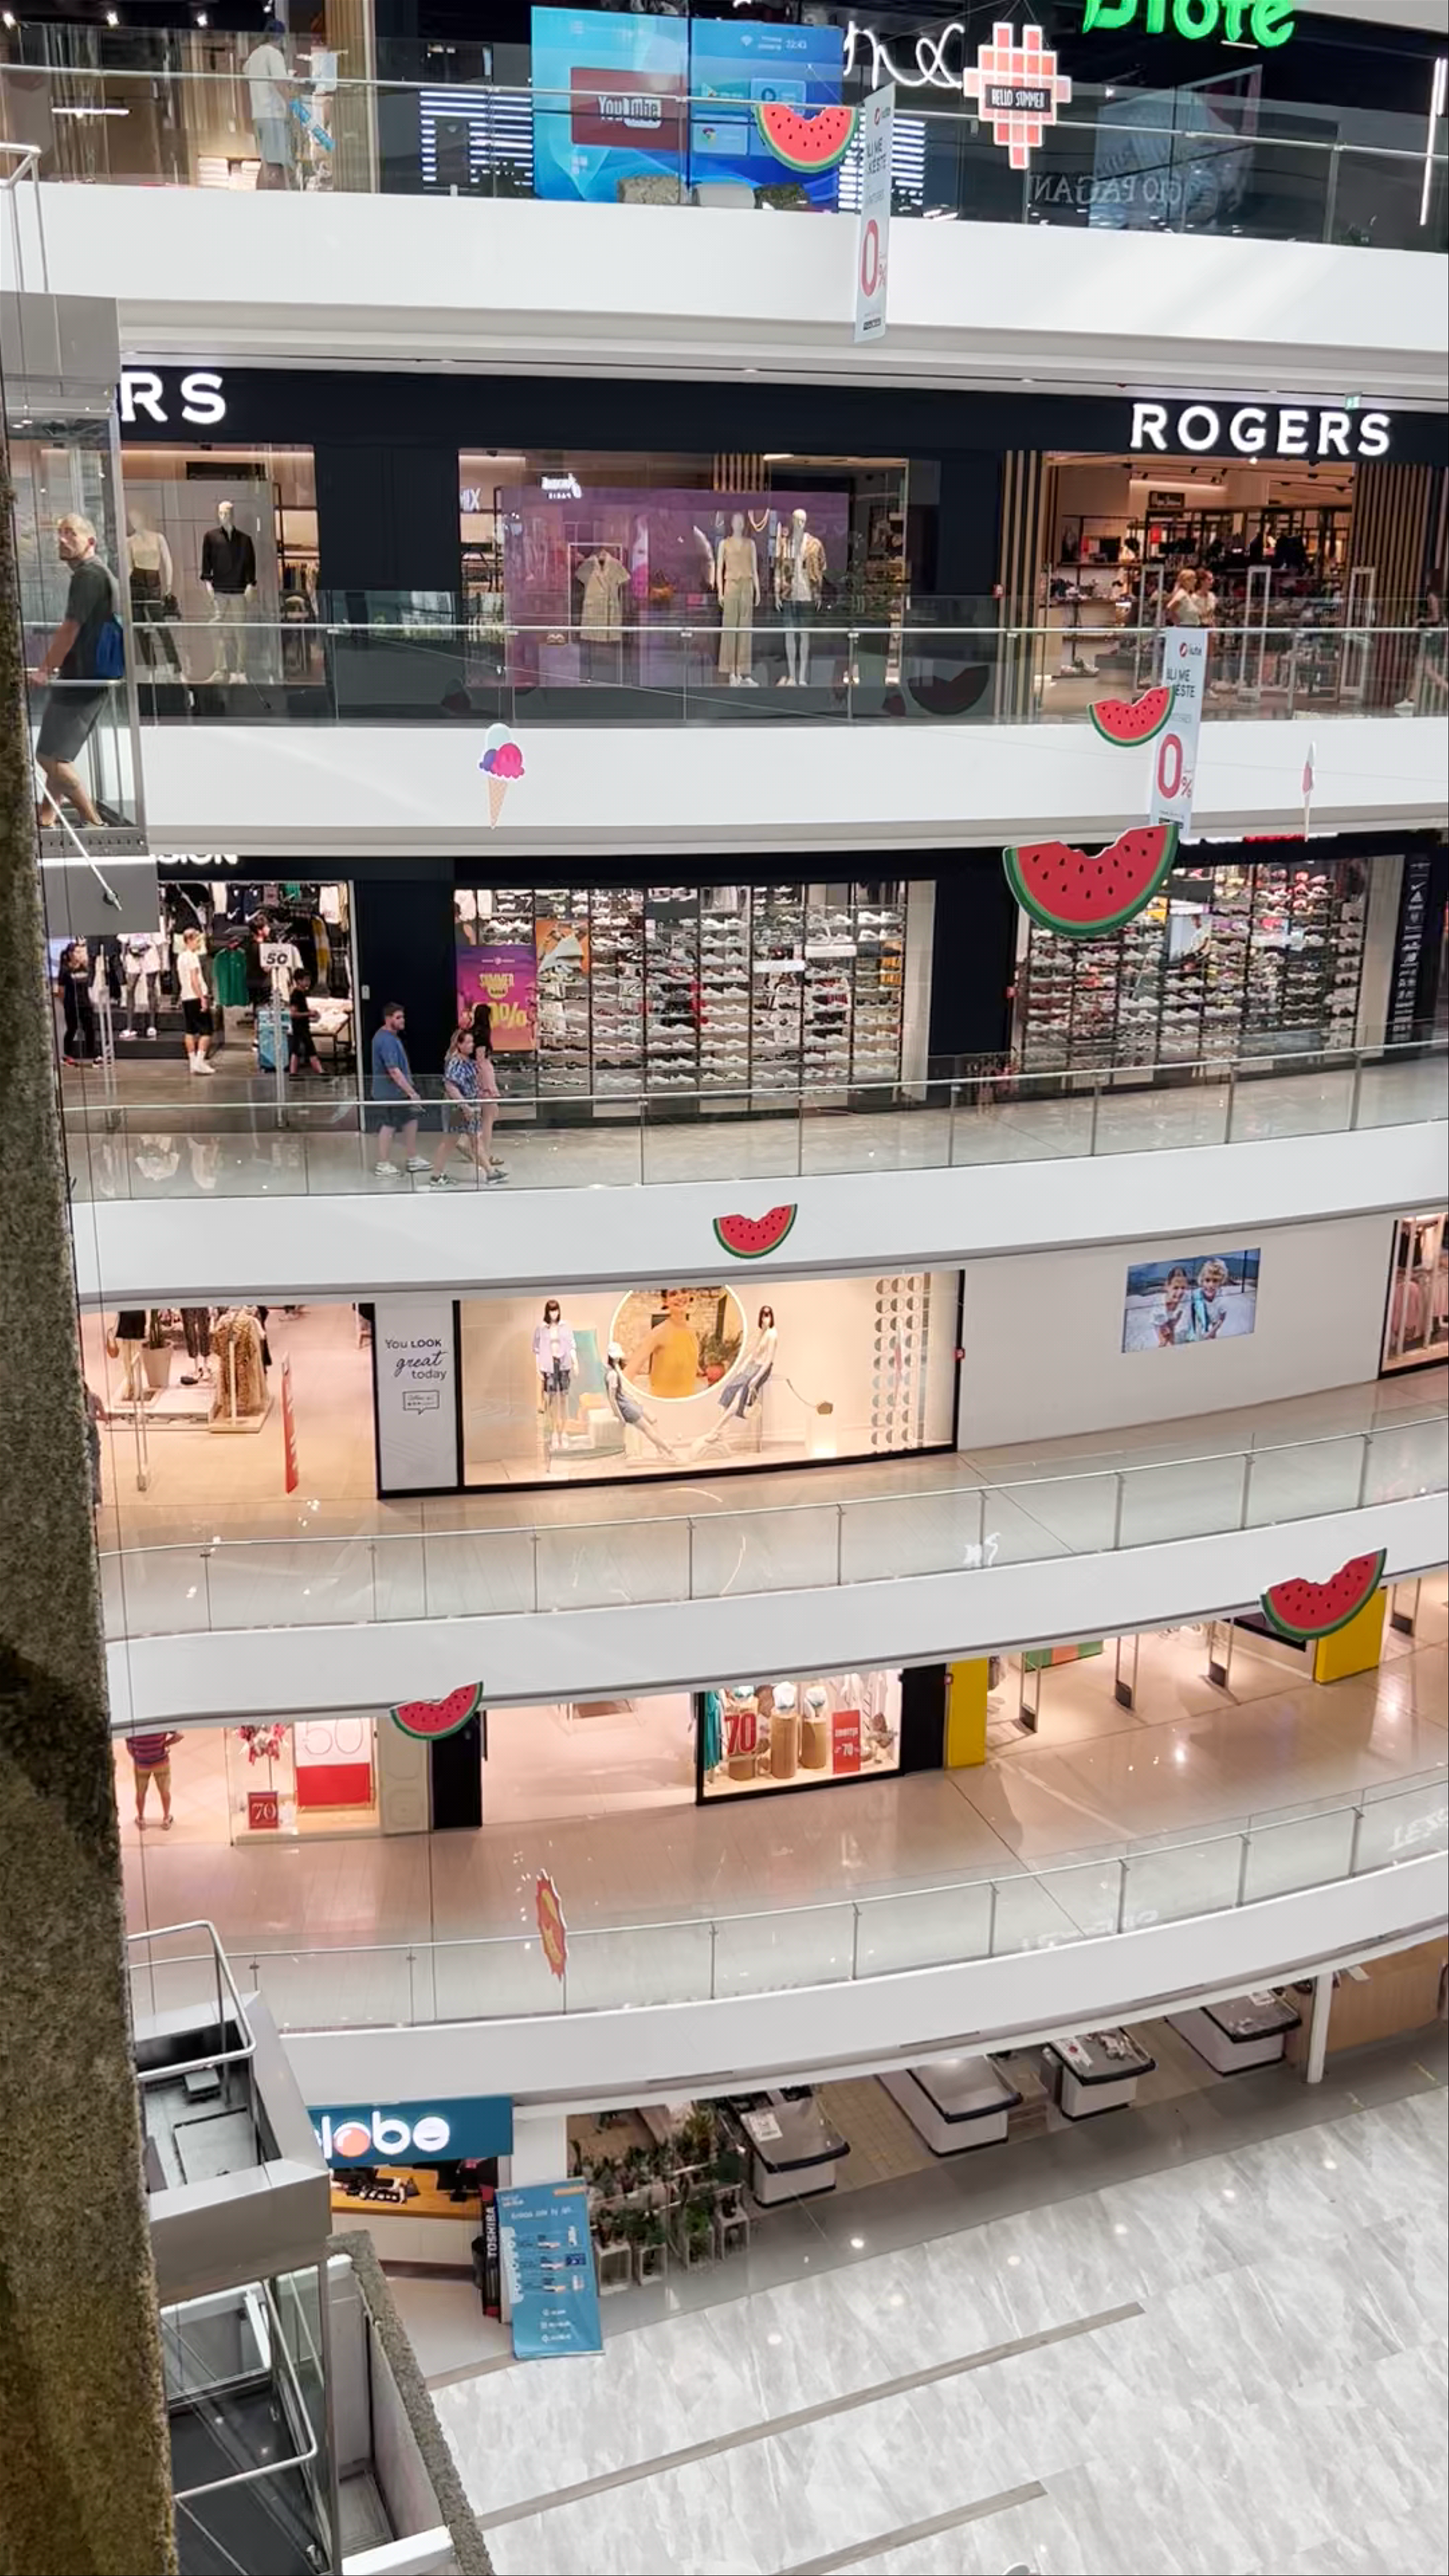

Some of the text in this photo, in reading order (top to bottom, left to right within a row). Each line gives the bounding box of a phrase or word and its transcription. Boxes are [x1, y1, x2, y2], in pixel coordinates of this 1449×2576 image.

[992, 88, 1045, 109] HELLO SUMMER
[1130, 402, 1391, 456] ROGERS
[479, 973, 515, 987] SUMMER
[385, 1339, 441, 1349] You LOOK
[394, 1350, 448, 1378] great
[412, 1370, 447, 1381] today
[724, 1712, 757, 1757] 70
[251, 1802, 277, 1820] 70
[306, 2111, 450, 2159] lobe
[486, 2207, 498, 2257] TOSHIBA
